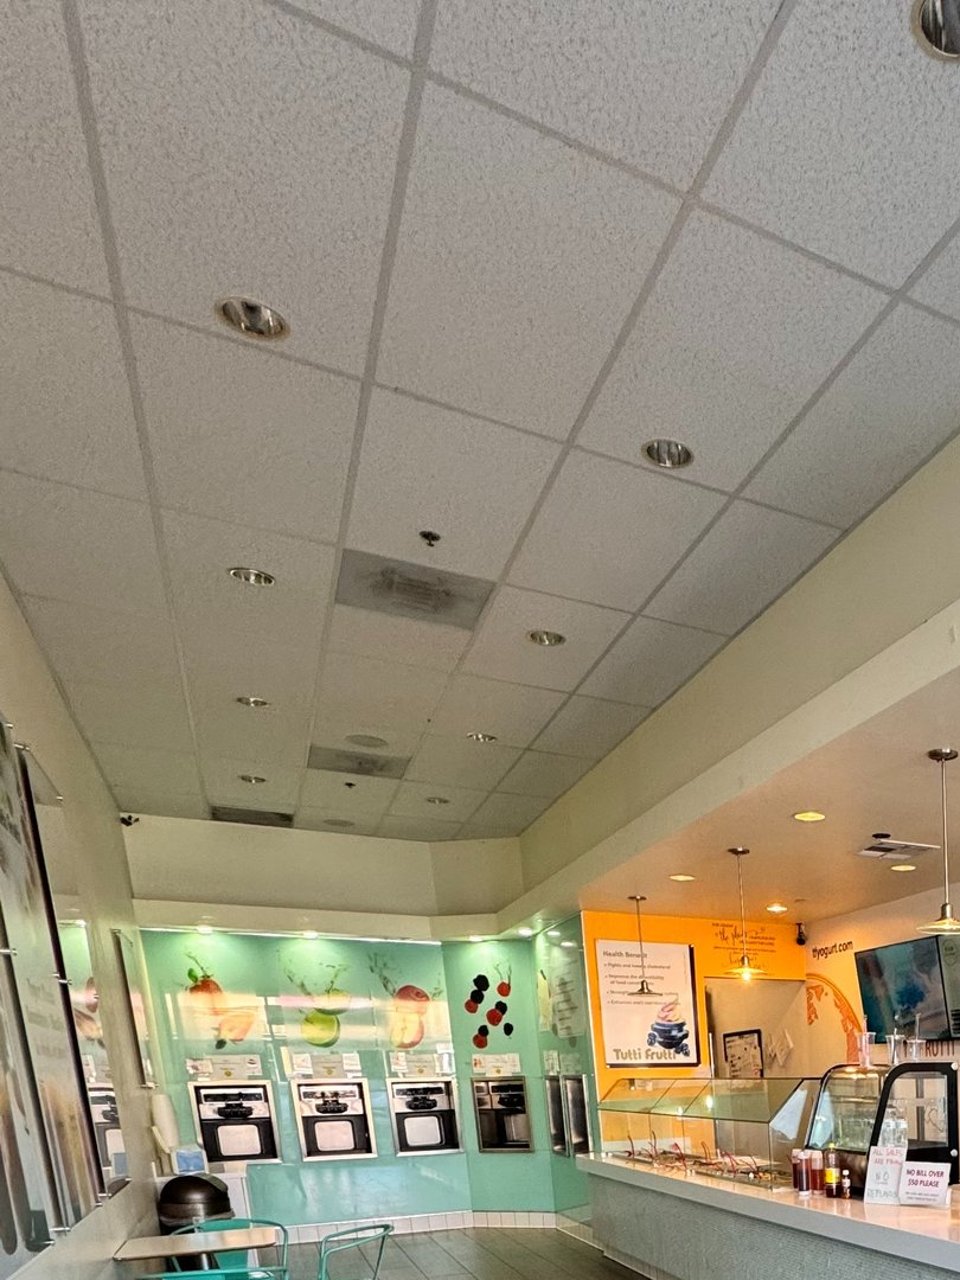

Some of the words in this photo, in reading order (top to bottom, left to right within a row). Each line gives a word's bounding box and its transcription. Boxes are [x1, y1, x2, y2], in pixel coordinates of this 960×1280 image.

[613, 1048, 642, 1060] Tutti
[916, 1168, 928, 1177] BILL
[928, 1170, 945, 1178] OVER
[919, 1179, 939, 1188] PLEASE
